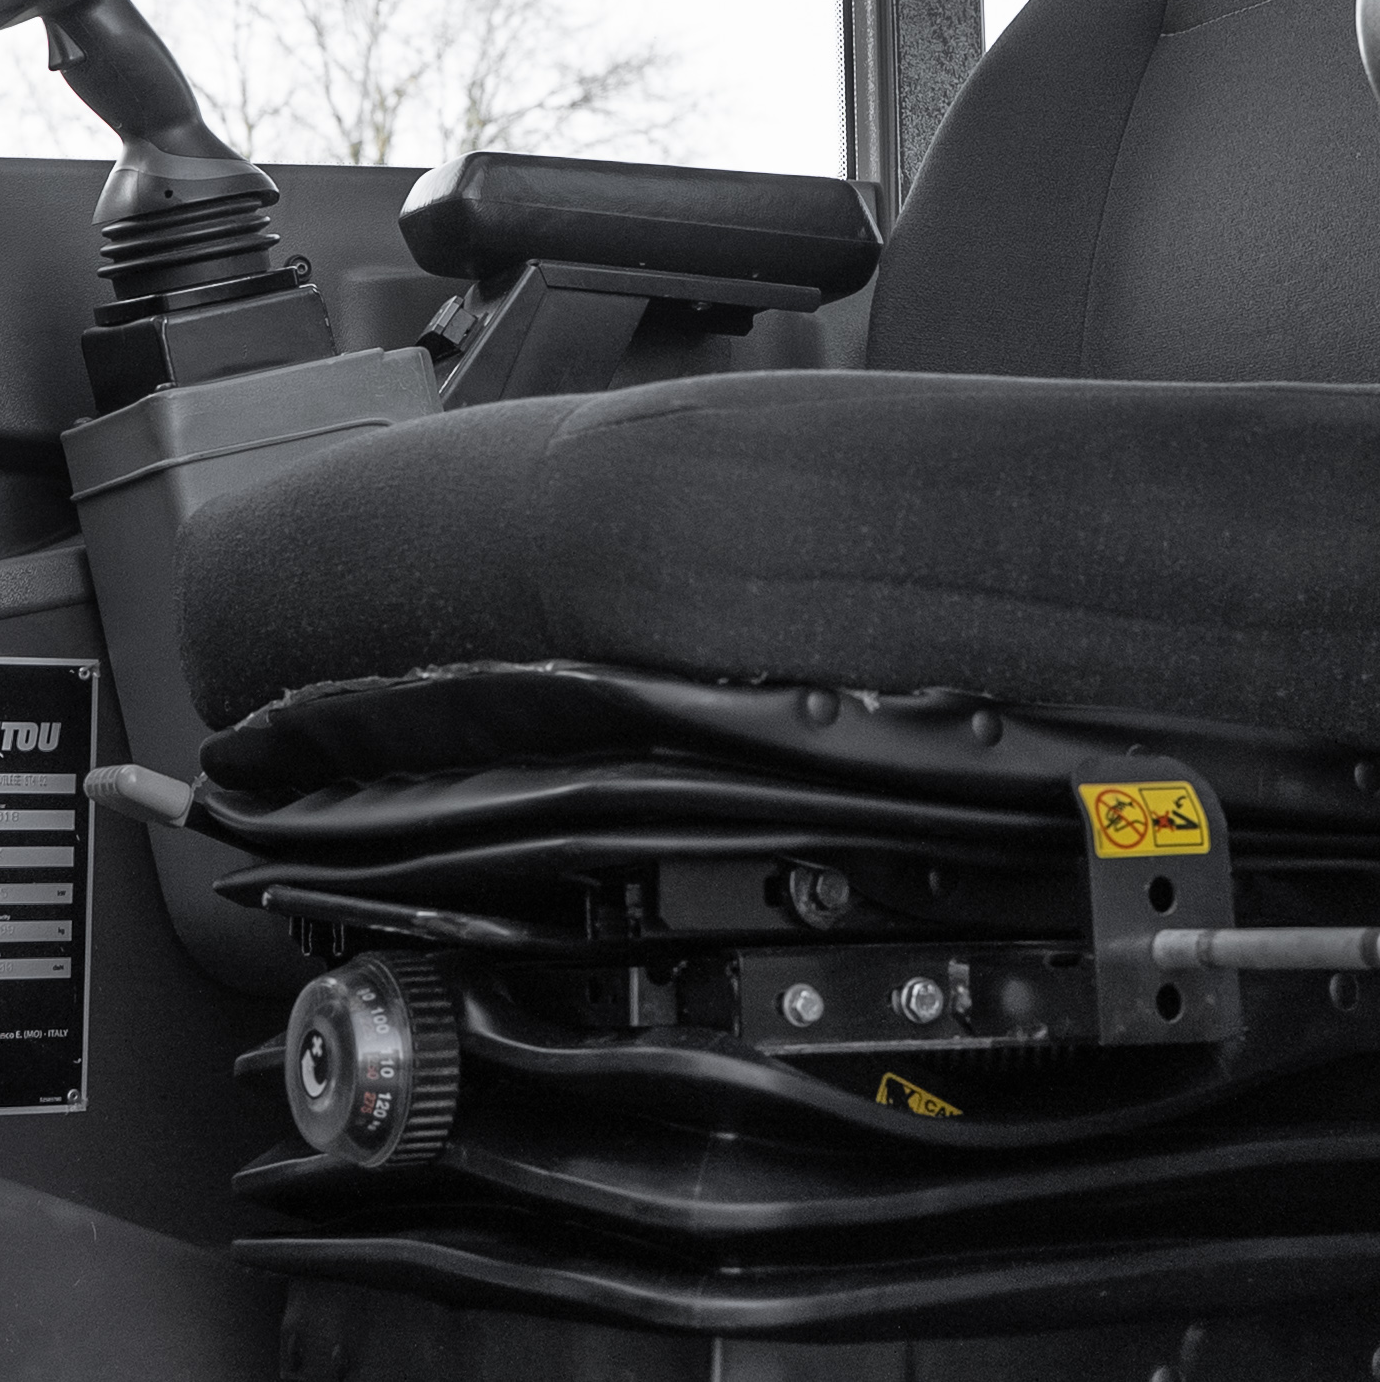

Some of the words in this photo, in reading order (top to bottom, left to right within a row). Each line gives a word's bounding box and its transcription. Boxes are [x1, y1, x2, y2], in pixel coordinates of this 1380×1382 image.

[15, 1030, 23, 1039] E.
[23, 1028, 43, 1040] (MO)
[47, 1027, 69, 1038] ITALY
[371, 1007, 390, 1035] 100
[373, 1092, 392, 1119] 120
